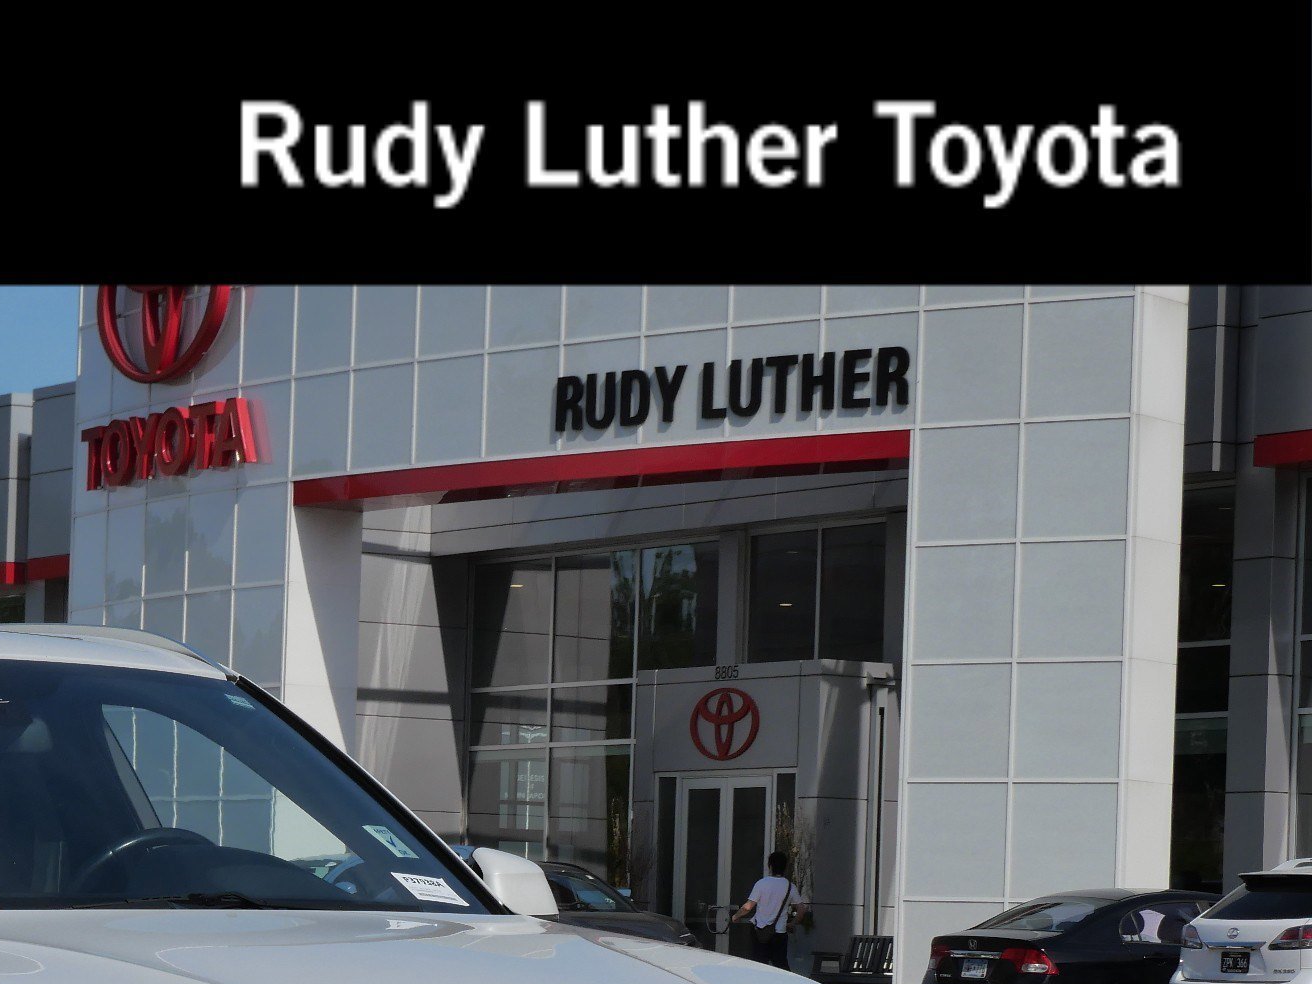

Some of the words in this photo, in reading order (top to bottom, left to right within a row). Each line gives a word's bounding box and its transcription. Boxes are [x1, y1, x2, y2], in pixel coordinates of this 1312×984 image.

[554, 364, 687, 433] RUDY
[701, 346, 912, 421] LUTHER
[80, 397, 257, 492] TOYOTA
[715, 665, 739, 680] 8805
